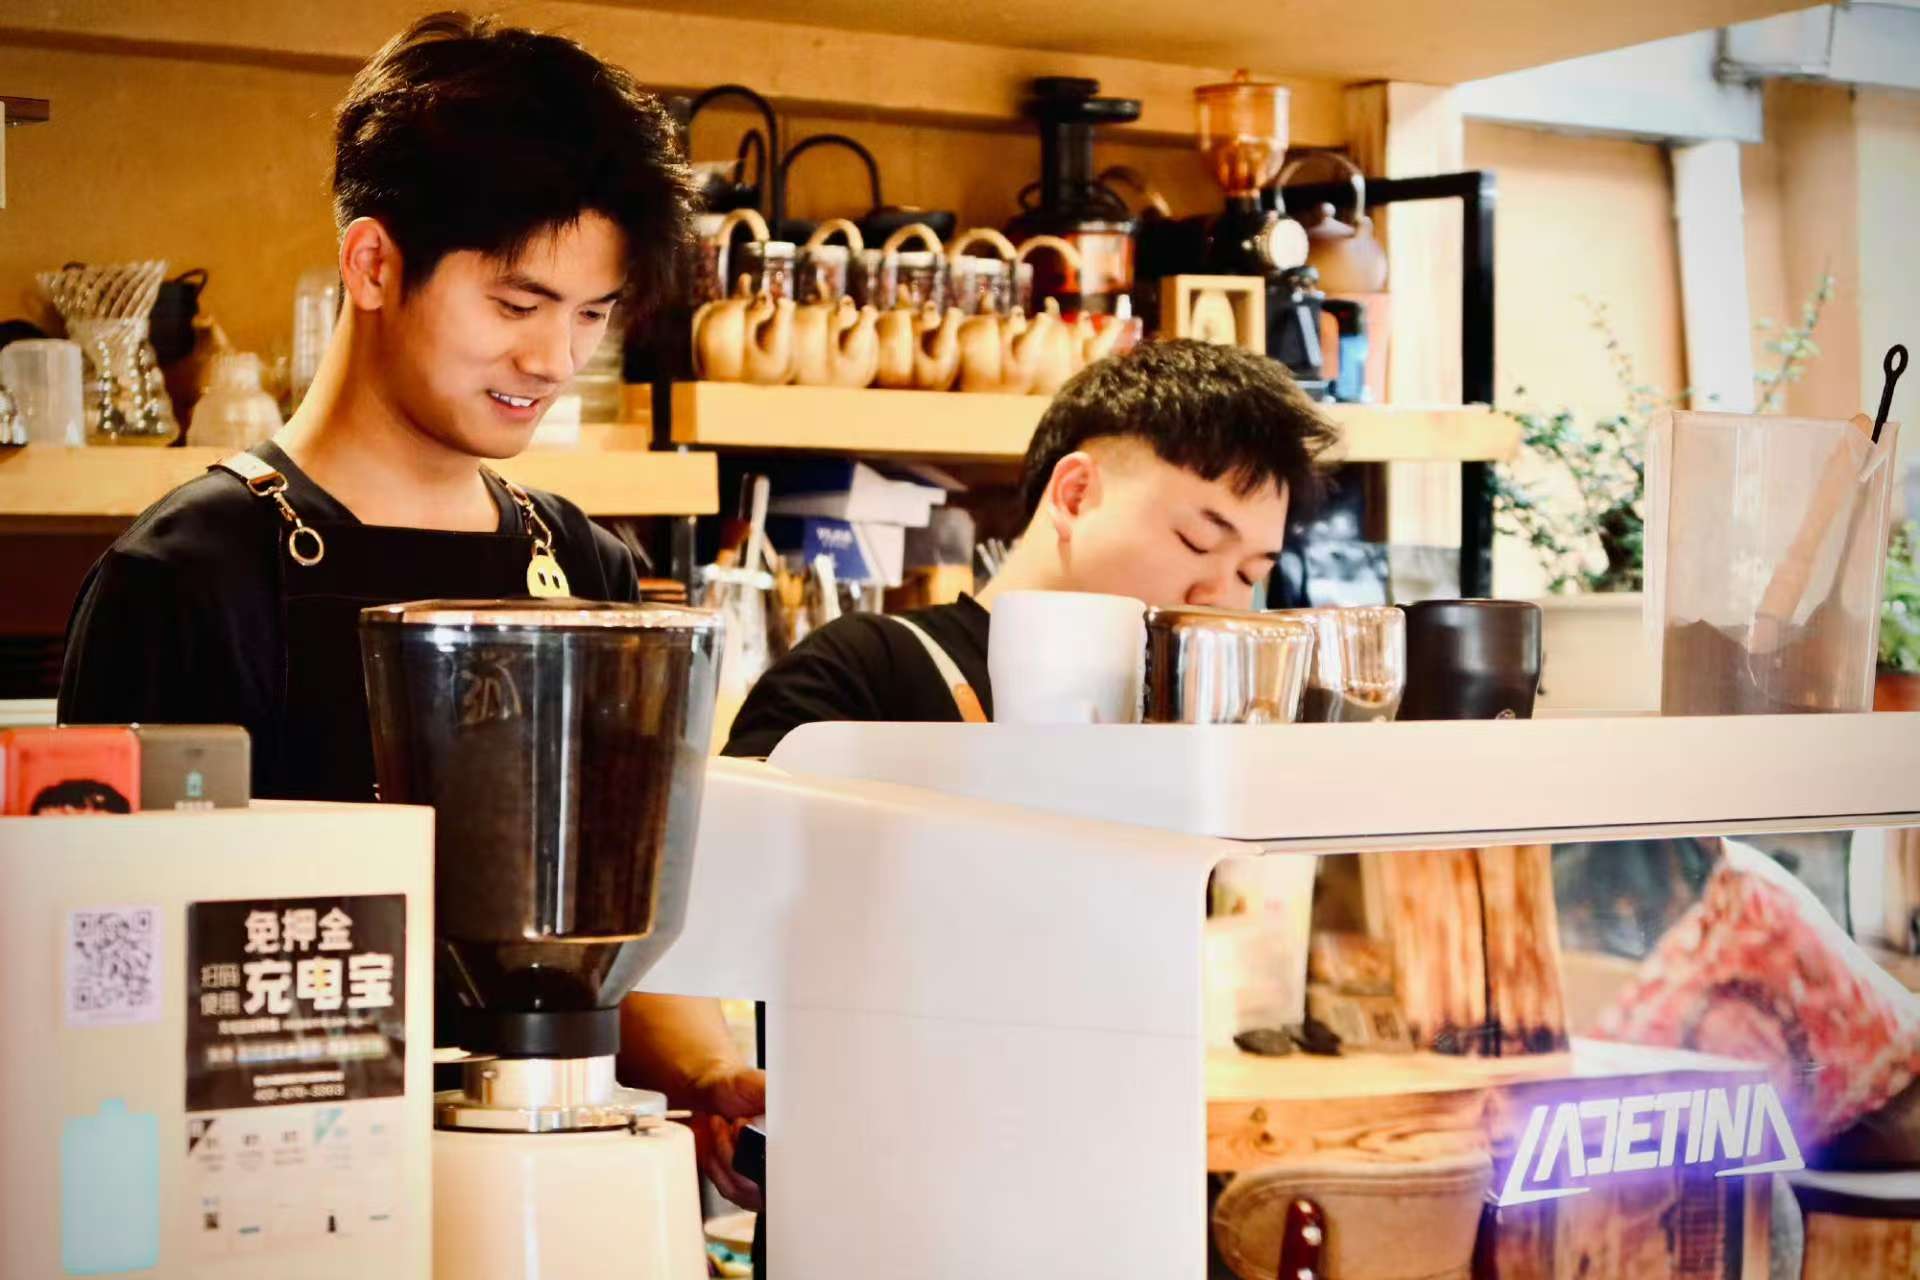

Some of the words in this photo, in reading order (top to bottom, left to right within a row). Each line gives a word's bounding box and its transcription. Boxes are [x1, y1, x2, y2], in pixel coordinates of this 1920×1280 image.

[245, 907, 353, 953] 免押金
[243, 952, 394, 1014] 充电宝
